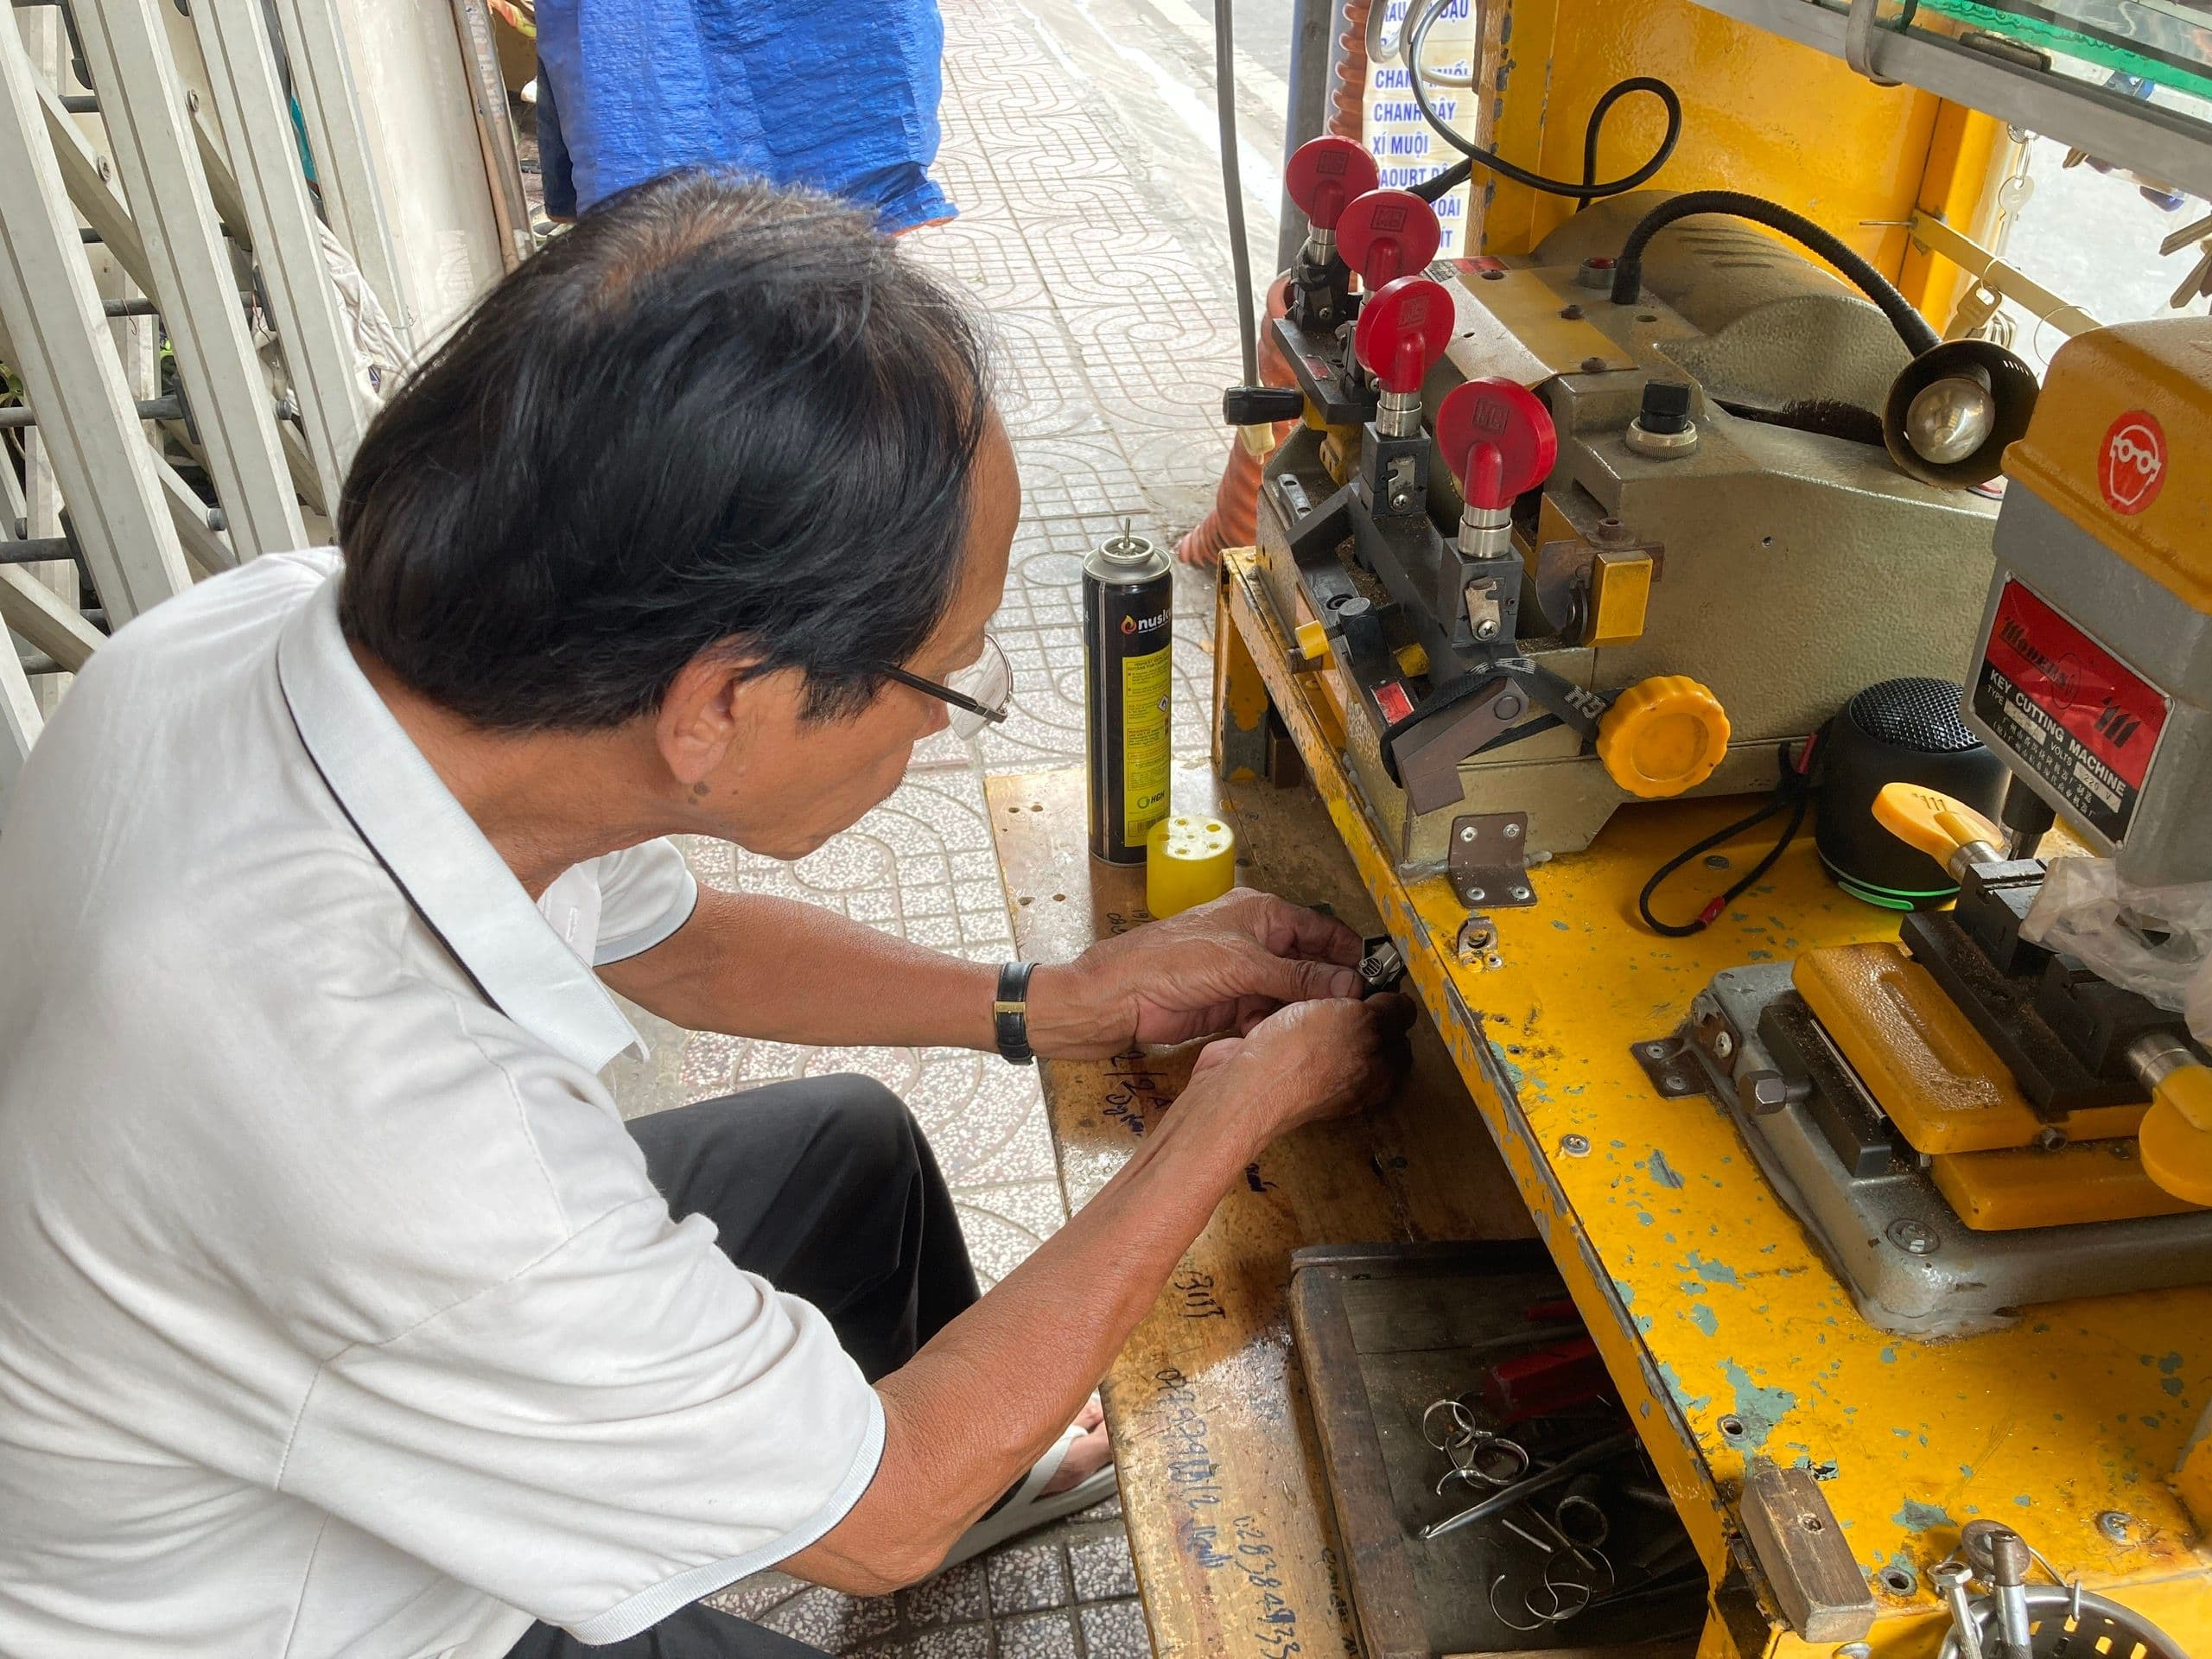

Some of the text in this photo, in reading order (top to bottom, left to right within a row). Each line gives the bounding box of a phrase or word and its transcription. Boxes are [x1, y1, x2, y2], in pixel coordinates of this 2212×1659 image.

[1372, 131, 1428, 159] XÍ MUỘI
[1987, 685, 2005, 706] TYPE
[2050, 742, 2073, 766] VOLTS
[2083, 773, 2099, 791] 220
[1990, 669, 2012, 694] KEY
[2015, 692, 2065, 743] CUTTING
[2069, 739, 2126, 798] MACHINE
